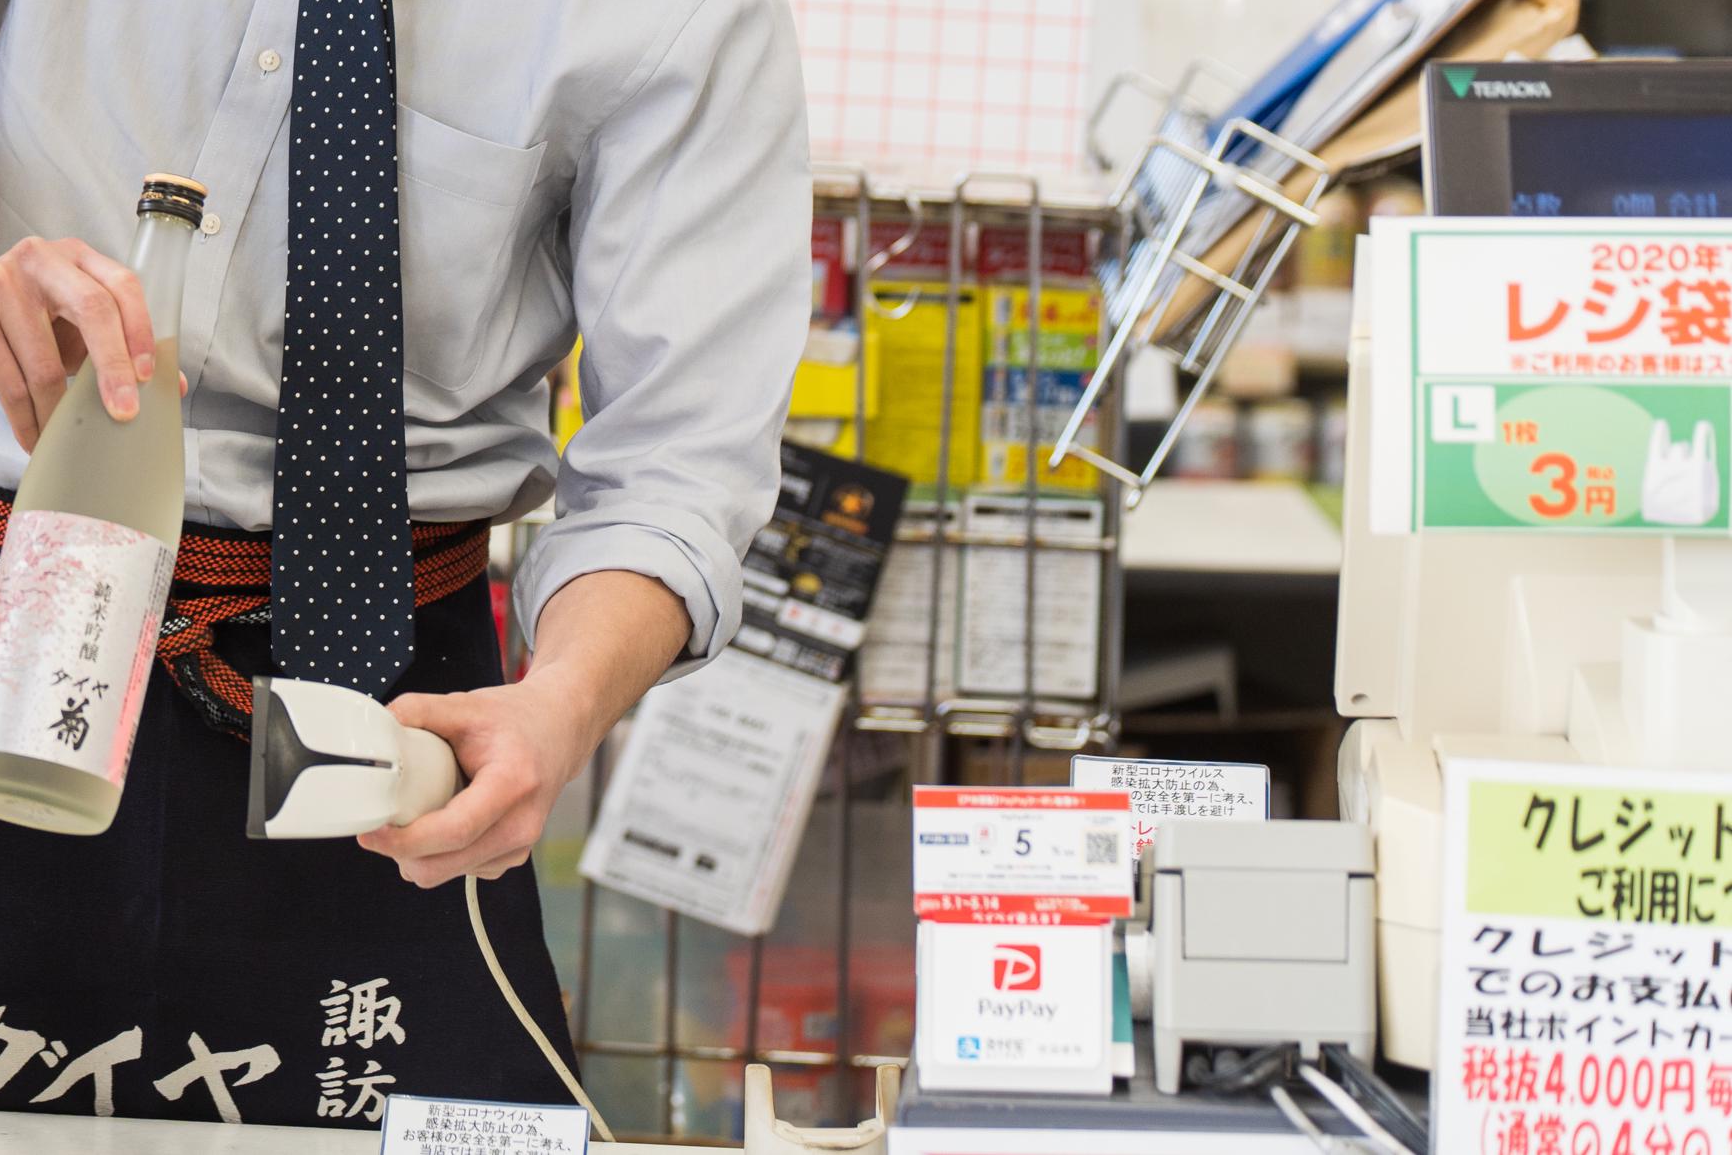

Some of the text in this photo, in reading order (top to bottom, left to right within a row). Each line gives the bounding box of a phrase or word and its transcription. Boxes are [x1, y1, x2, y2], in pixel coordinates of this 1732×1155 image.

[1471, 80, 1553, 100] TERAOKA
[1592, 244, 1732, 274] 2020年
[1508, 277, 1732, 347] レジ袋
[1510, 352, 1732, 376] ※ご利用のお客様はス
[1453, 394, 1478, 430] L
[1502, 420, 1539, 445] 1枚
[79, 582, 112, 663] 純米吟醸
[48, 697, 90, 751] 菊
[1112, 764, 1225, 779] 新型コロナウイルス
[1111, 777, 1226, 792] 感染拡大防止の為、
[1014, 830, 1031, 855] 5
[1578, 868, 1732, 925] ご利用に
[1466, 966, 1732, 1010] でのお支払
[978, 998, 1058, 1021] PayPay
[315, 976, 407, 1121] 諏訪
[427, 1103, 544, 1123] 新型コロナウイルス
[425, 1117, 544, 1137] 感染拡大防止の為、
[403, 1129, 572, 1152] お客様の安全を第一に考え、
